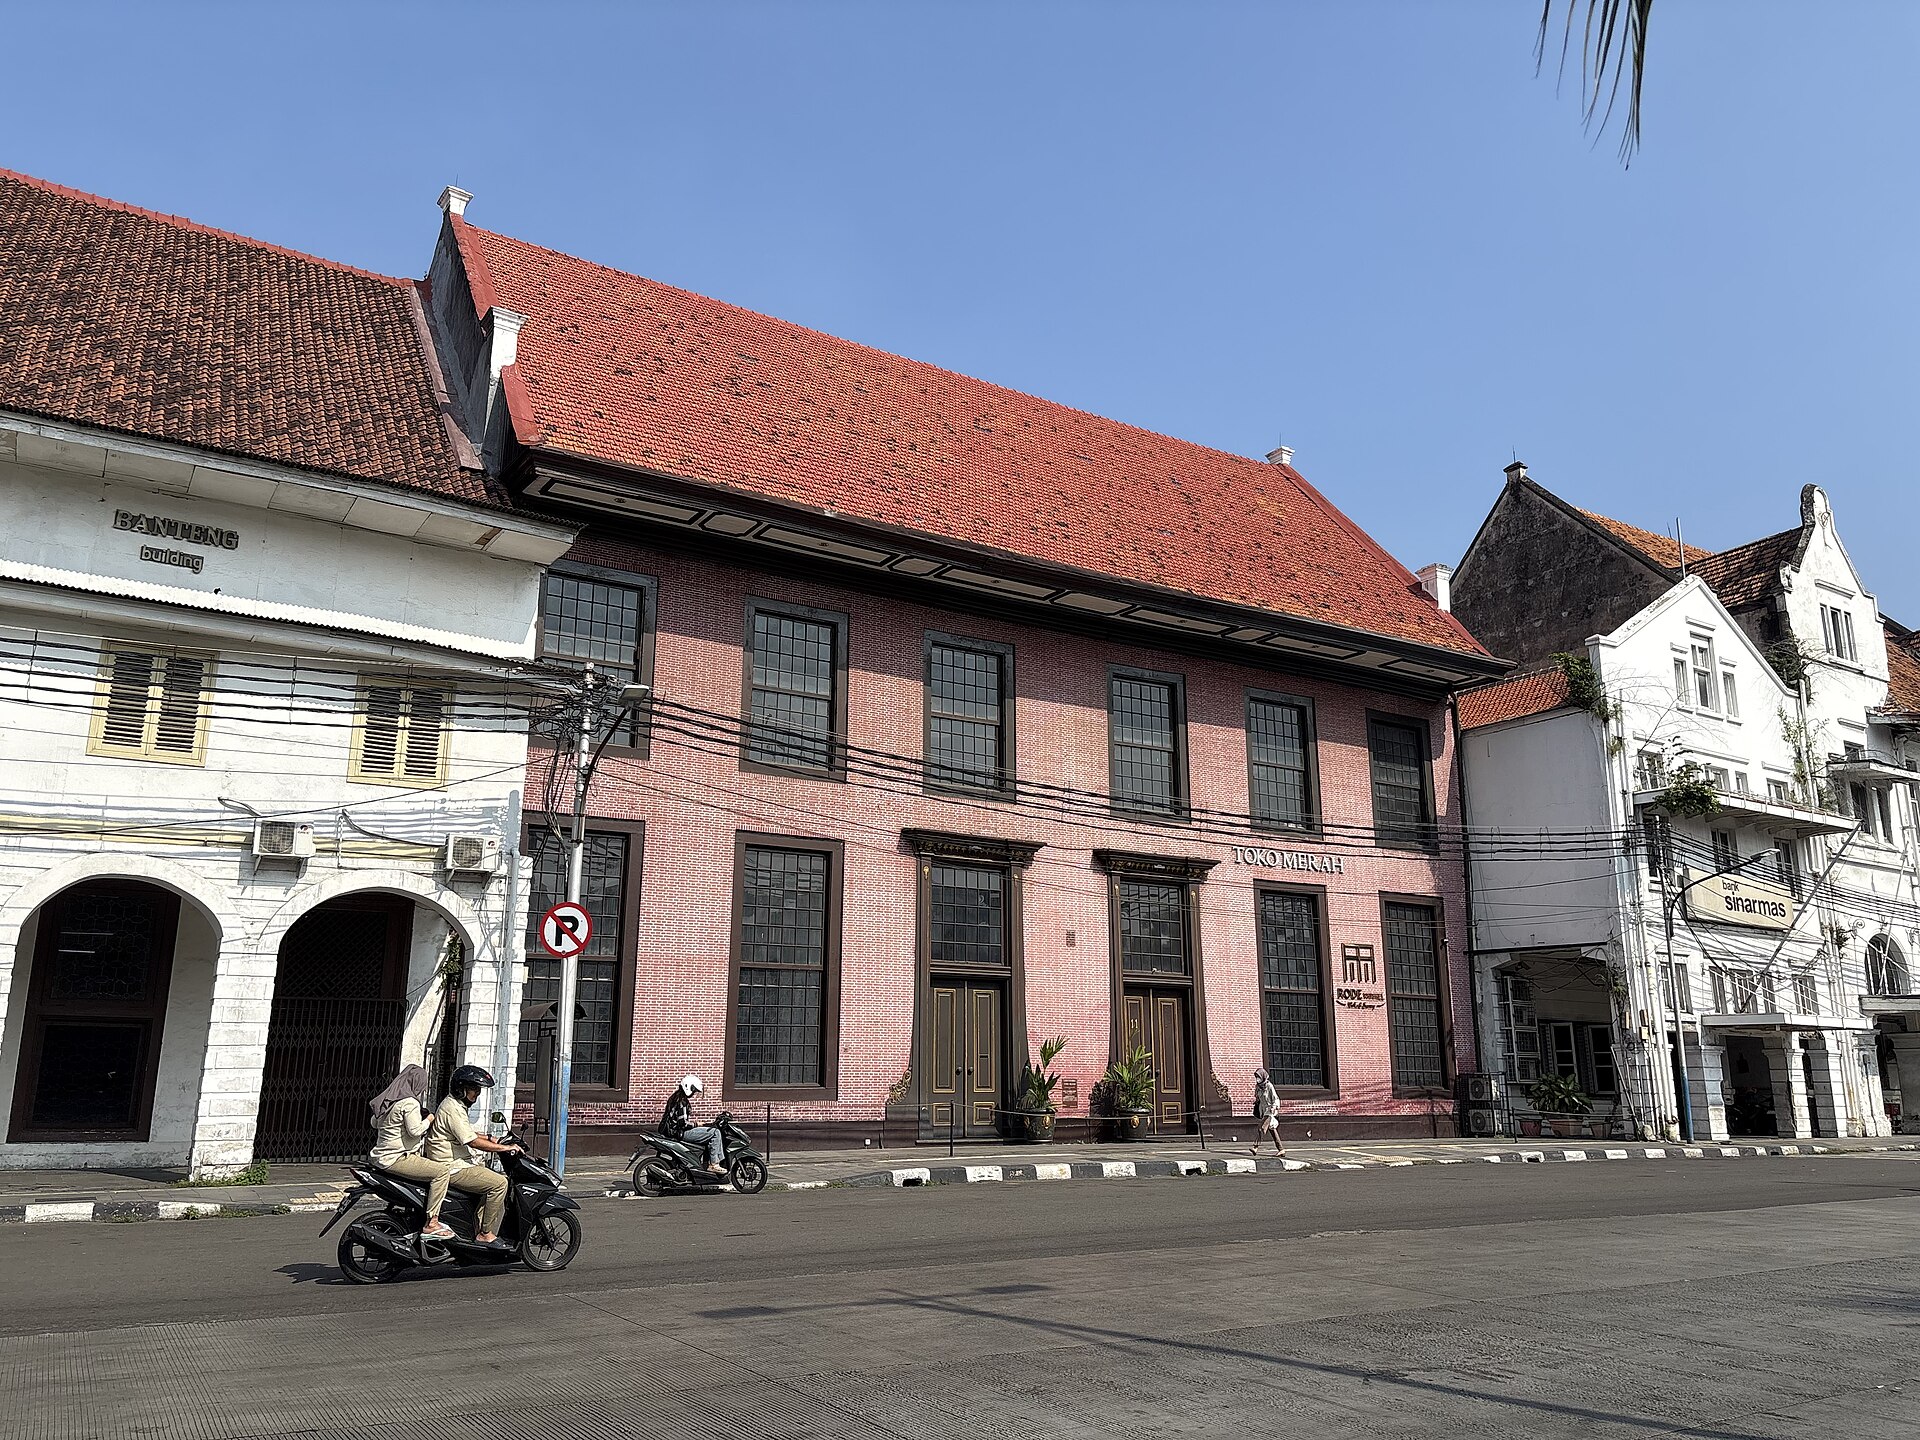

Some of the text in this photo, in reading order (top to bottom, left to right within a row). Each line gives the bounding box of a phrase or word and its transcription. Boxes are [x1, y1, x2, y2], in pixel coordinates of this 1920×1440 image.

[113, 509, 239, 549] BANTENG
[140, 545, 204, 574] building
[1232, 846, 1344, 874] TOKO MERAH
[1722, 880, 1739, 892] bank
[1724, 891, 1786, 917] sinarmas
[555, 916, 579, 946] P
[1130, 1018, 1138, 1029] 11
